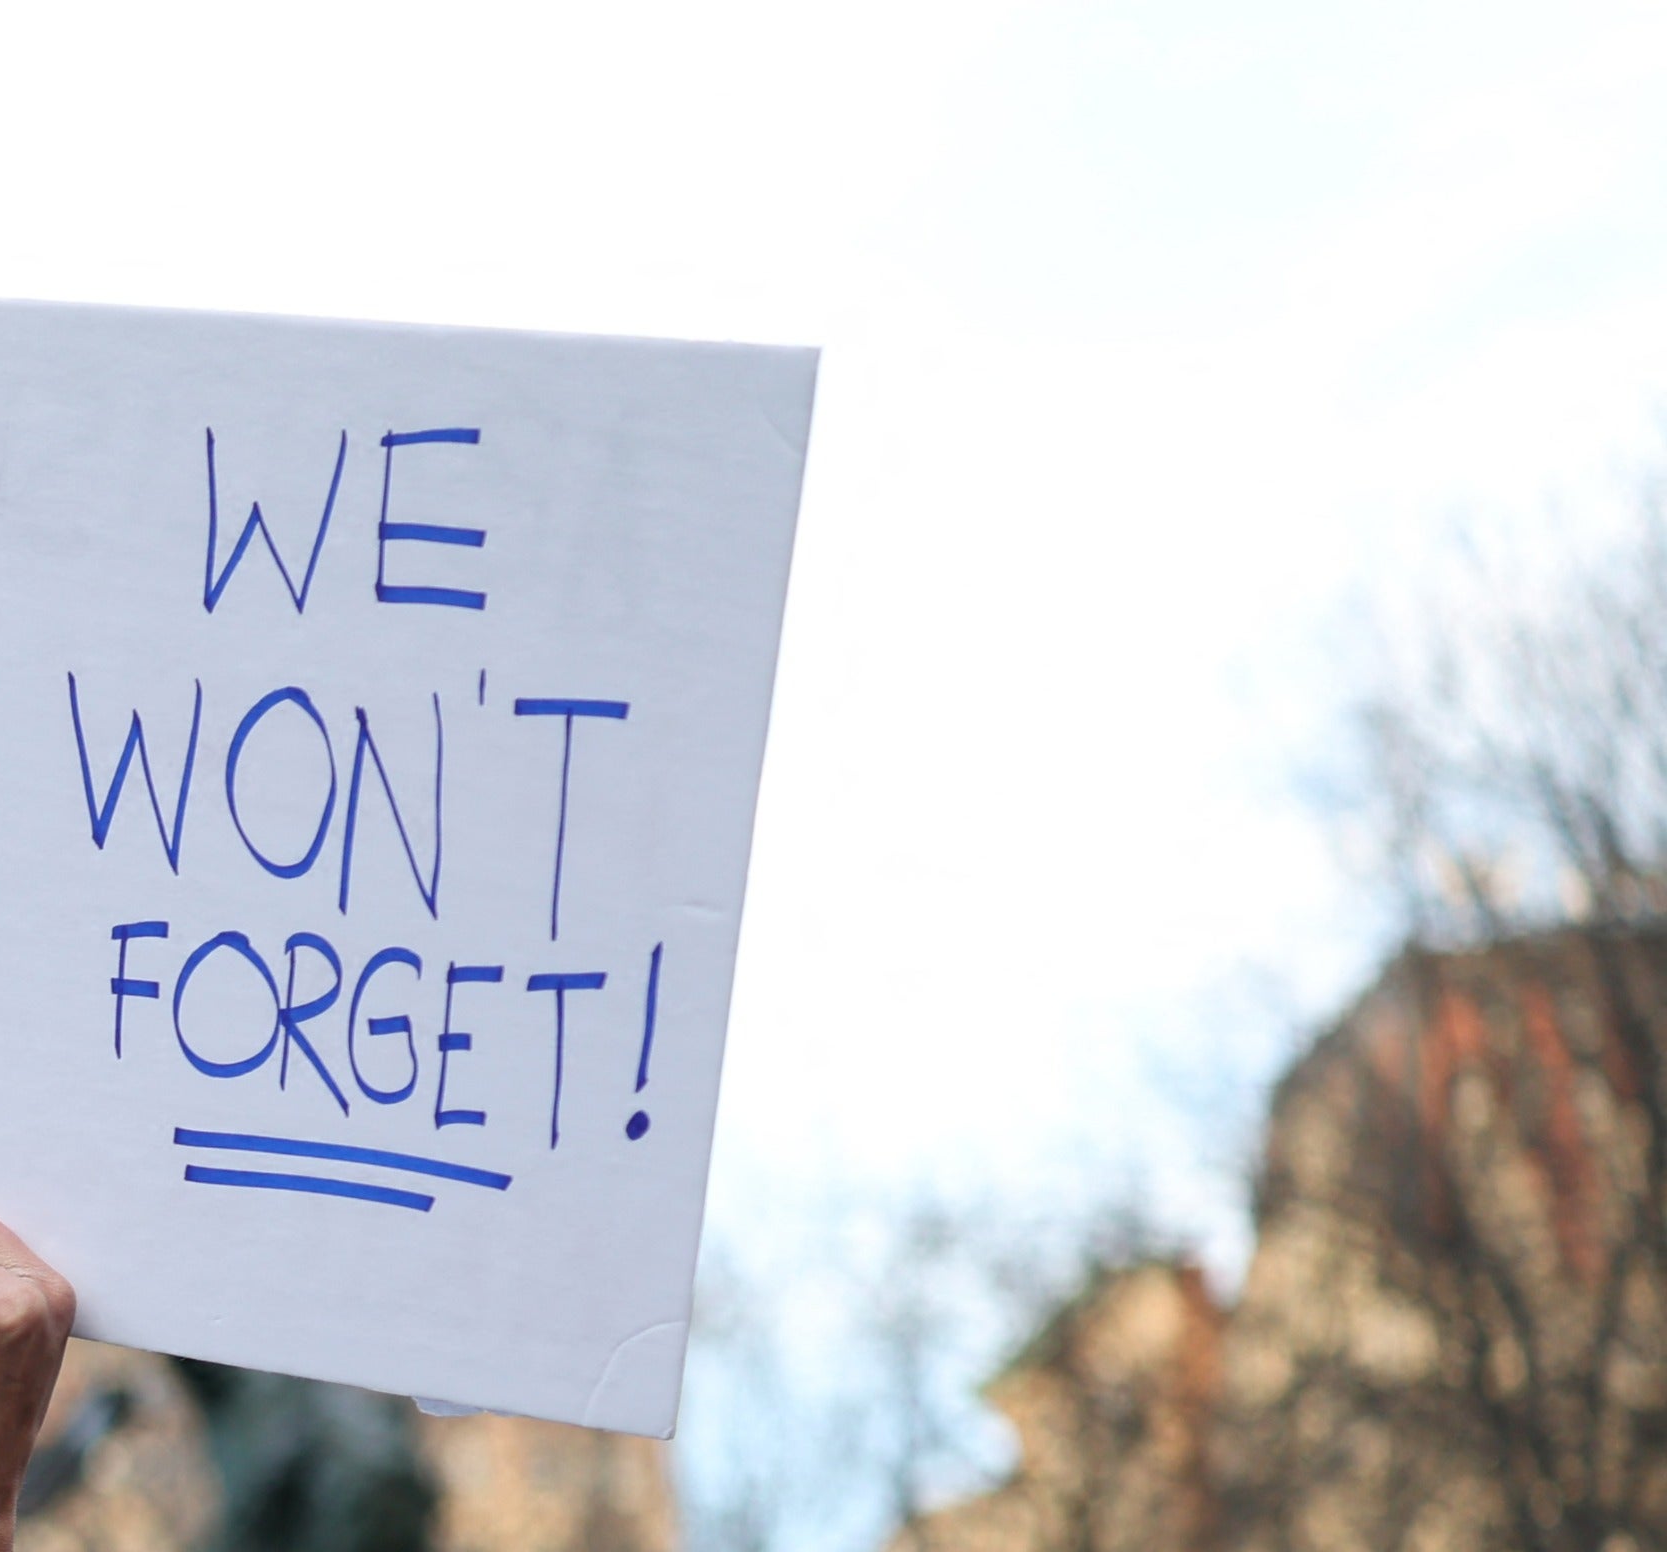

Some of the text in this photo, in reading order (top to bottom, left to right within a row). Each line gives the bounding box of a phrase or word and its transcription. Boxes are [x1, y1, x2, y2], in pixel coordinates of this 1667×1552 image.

[203, 426, 488, 614] WE
[68, 668, 631, 942] WON'T
[110, 920, 664, 1151] FORGET!
